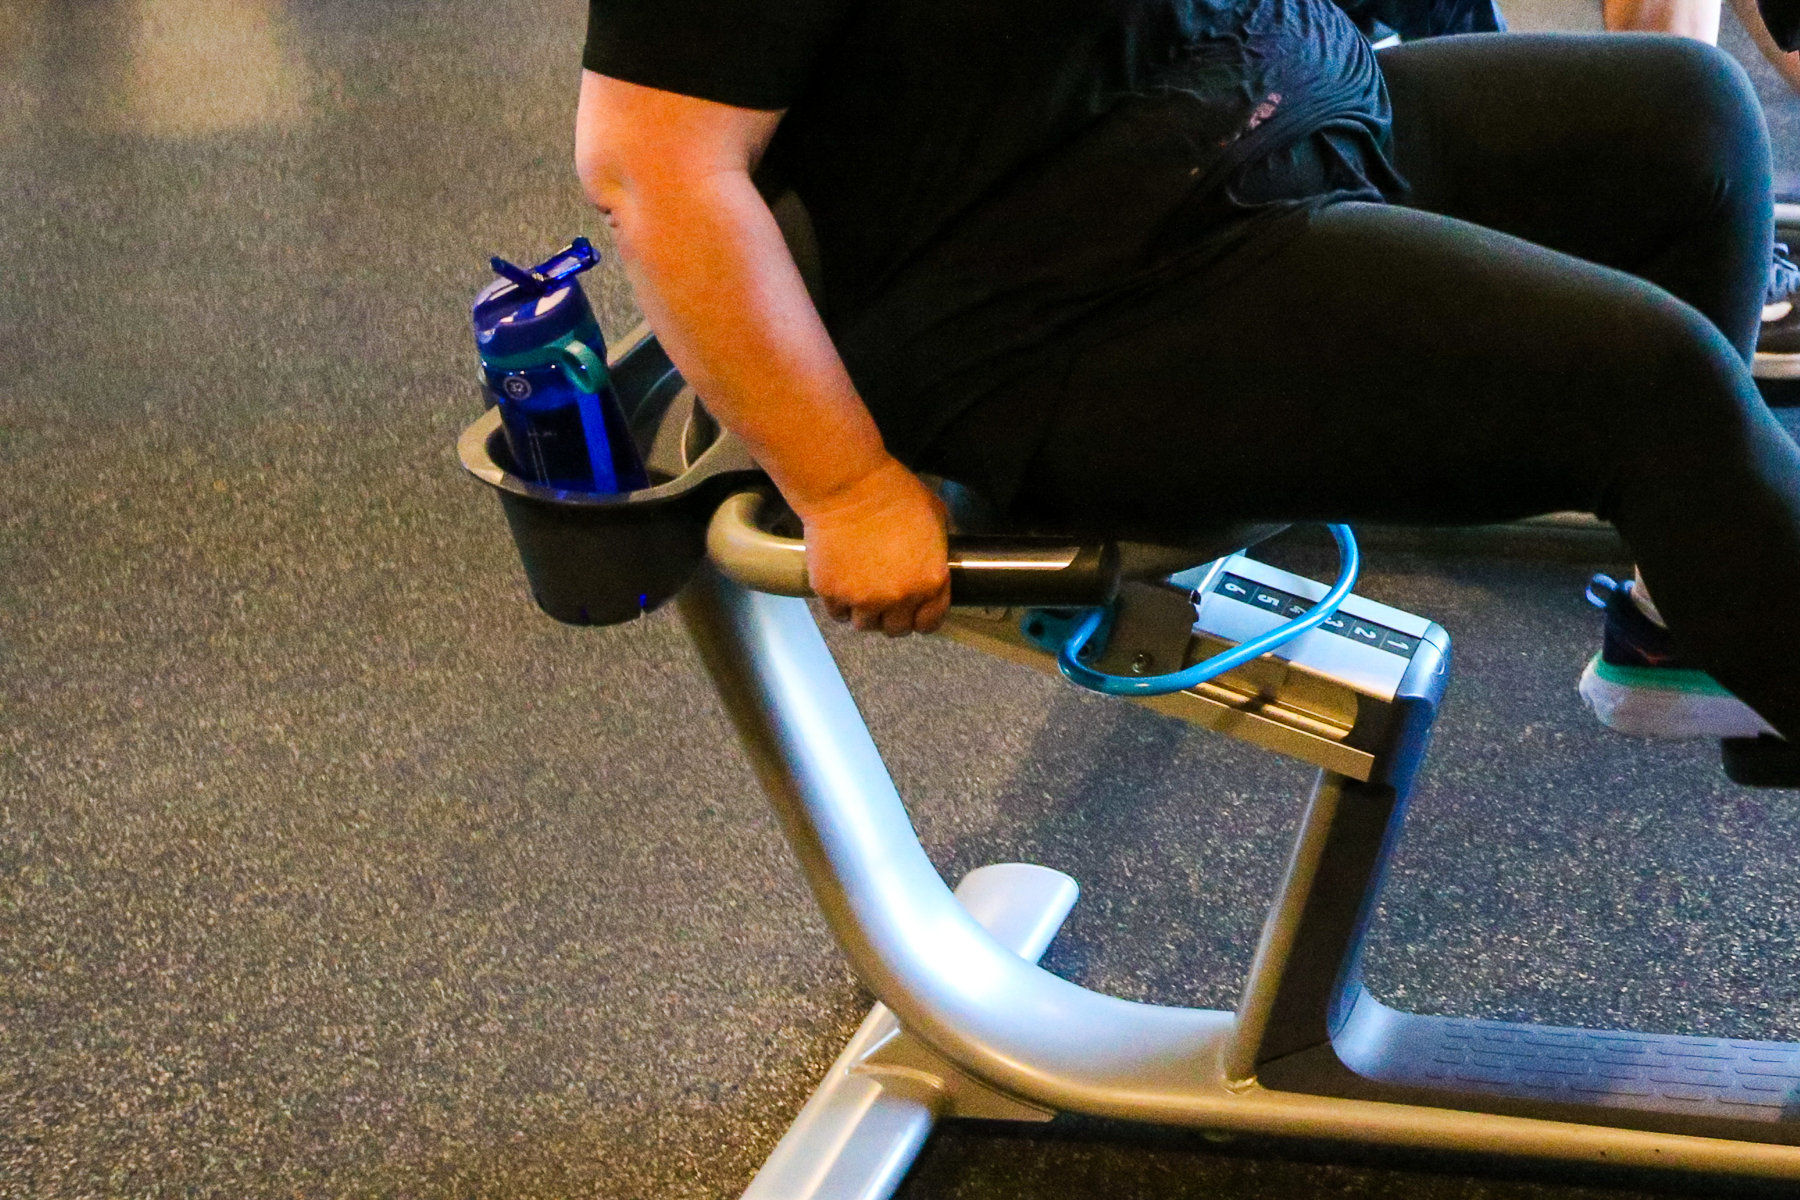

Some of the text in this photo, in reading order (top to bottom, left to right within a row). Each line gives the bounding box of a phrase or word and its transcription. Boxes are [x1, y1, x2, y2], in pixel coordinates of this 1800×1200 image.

[1225, 582, 1246, 595] 6
[1258, 593, 1280, 607] 5
[1324, 616, 1344, 628] 3
[1354, 627, 1377, 640] 2
[1387, 639, 1409, 651] 1
